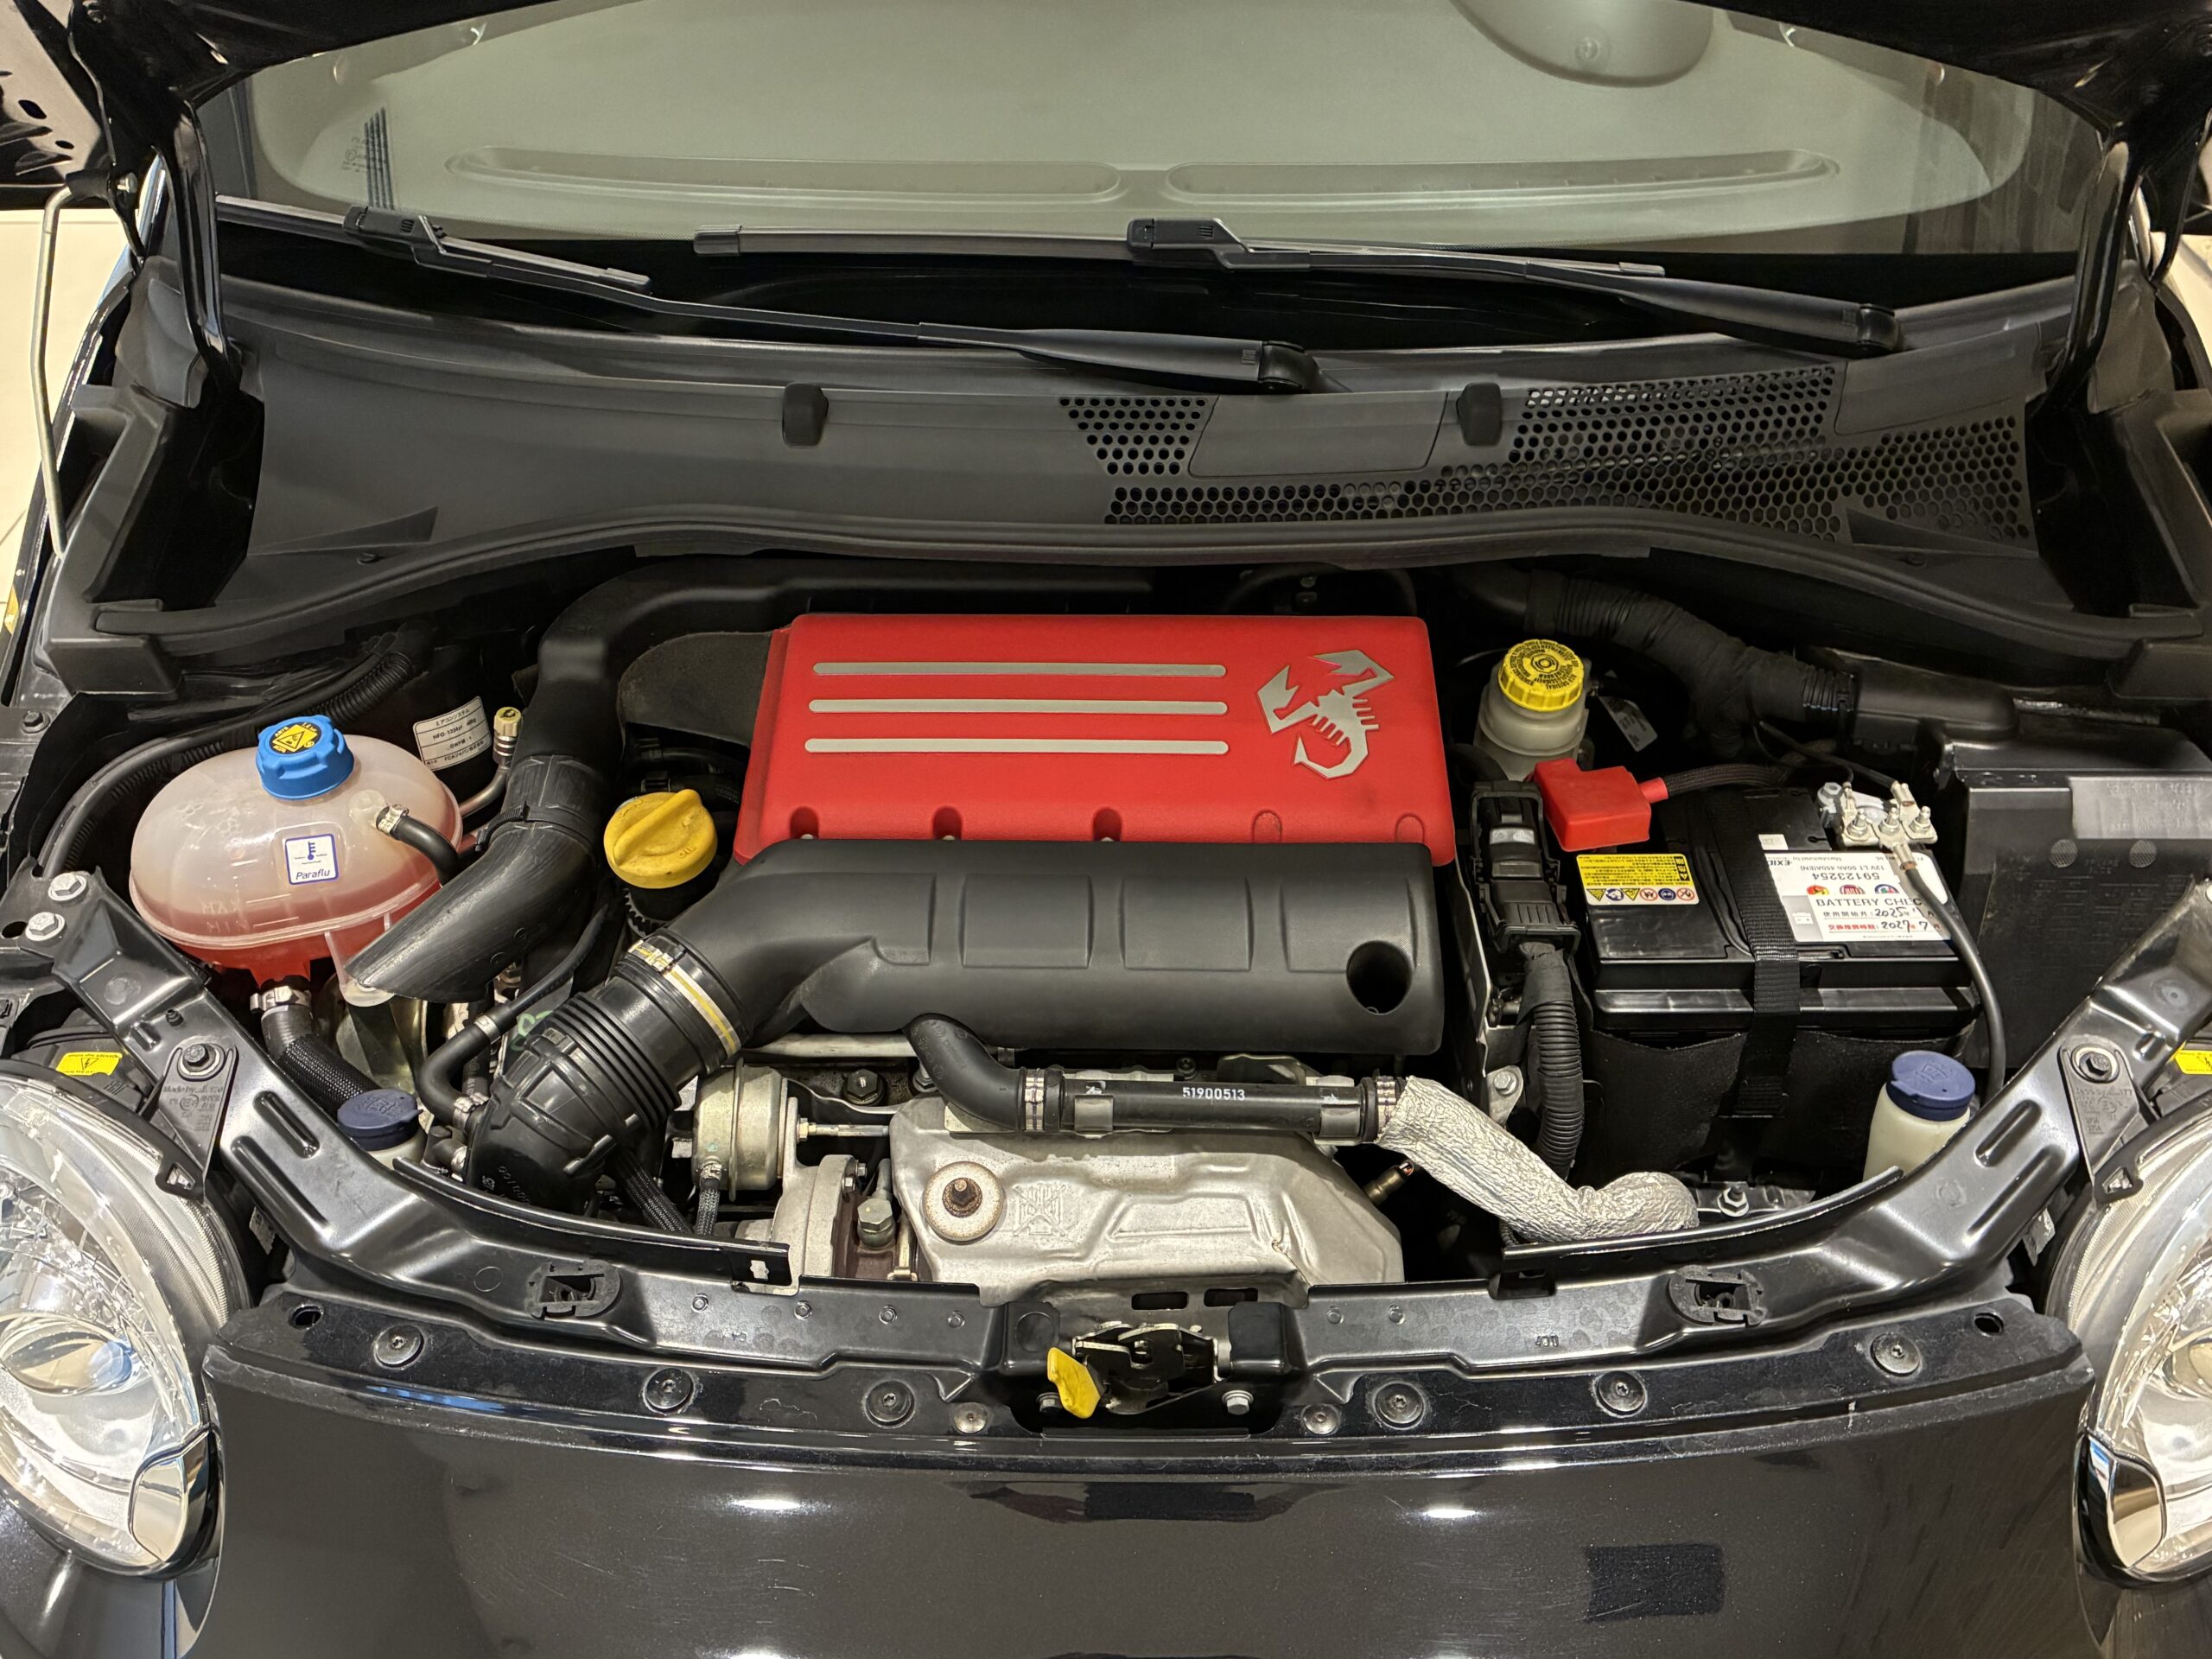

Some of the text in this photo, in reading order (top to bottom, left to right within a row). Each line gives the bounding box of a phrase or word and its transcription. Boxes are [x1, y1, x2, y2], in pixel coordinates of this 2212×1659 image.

[296, 868, 330, 880] Paraflu
[1812, 872, 1880, 881] 59123254
[1815, 898, 1923, 907] BATTERY CHEC
[1182, 1087, 1245, 1101] 51900513
